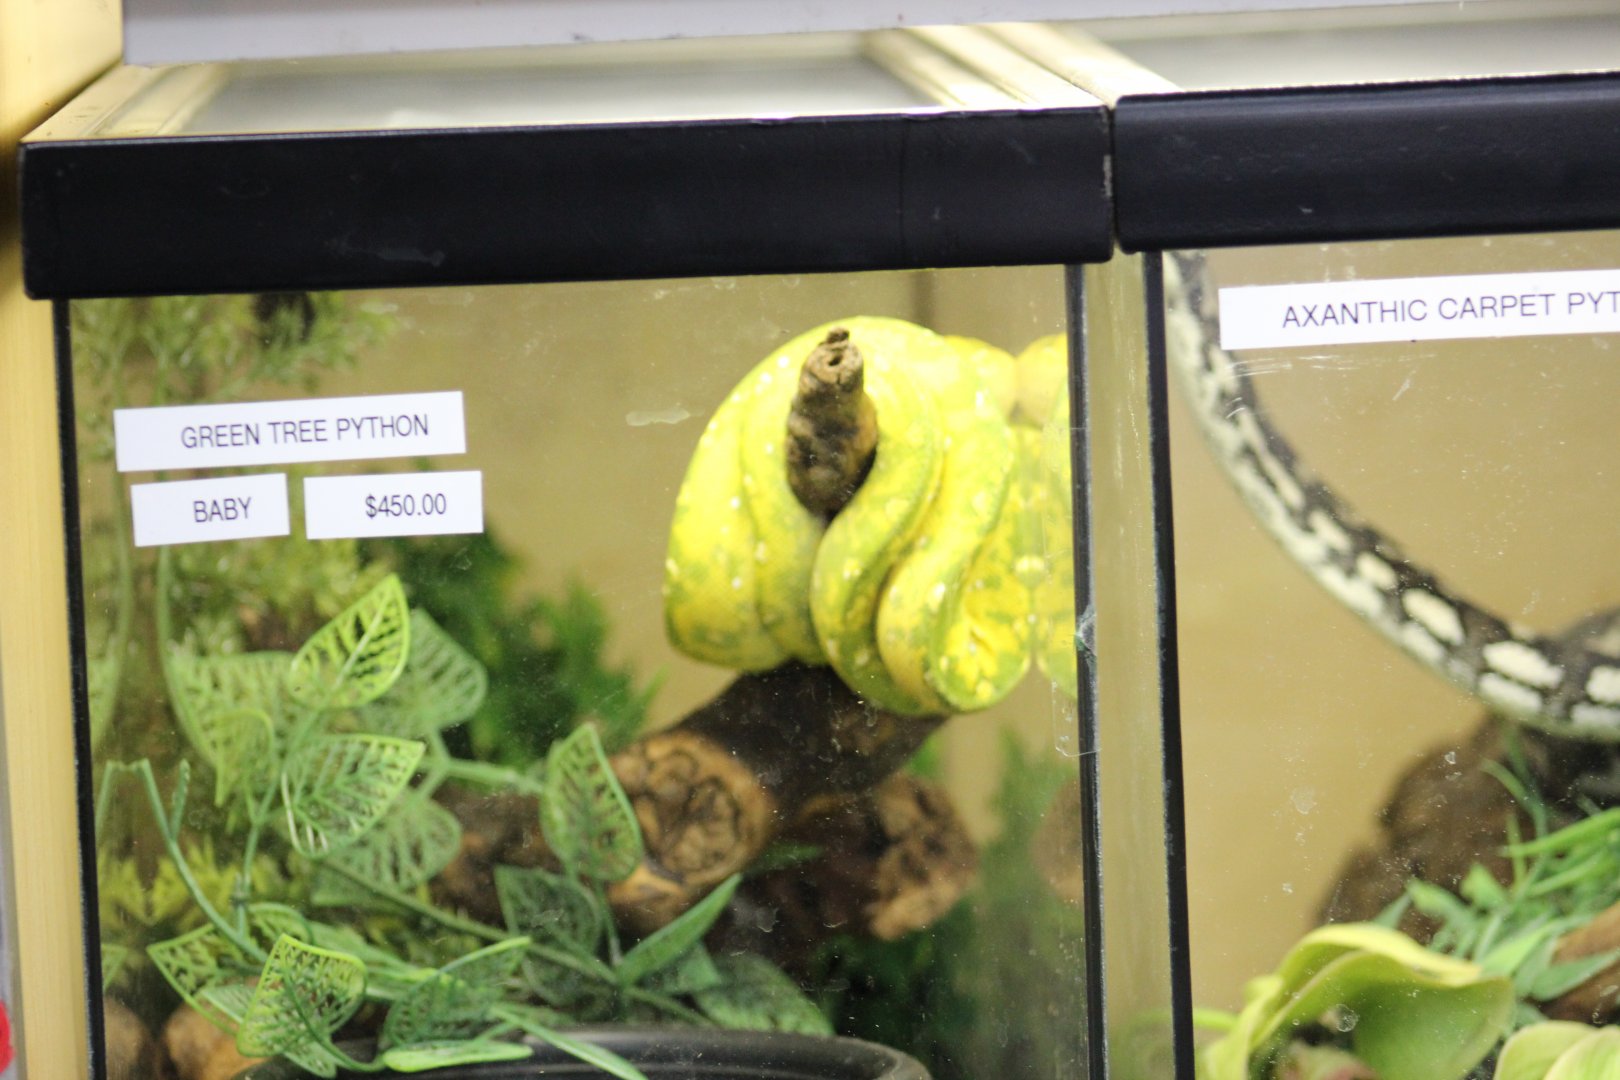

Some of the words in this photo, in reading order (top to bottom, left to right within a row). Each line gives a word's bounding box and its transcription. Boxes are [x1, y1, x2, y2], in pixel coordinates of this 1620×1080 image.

[1282, 299, 1428, 329] AXANTHIC
[1437, 293, 1556, 320] CARPET
[181, 423, 261, 449] GREEN
[268, 419, 328, 444] TREE
[336, 414, 430, 441] PYTHON
[193, 497, 252, 523] BABY
[365, 493, 448, 518] $450.00
